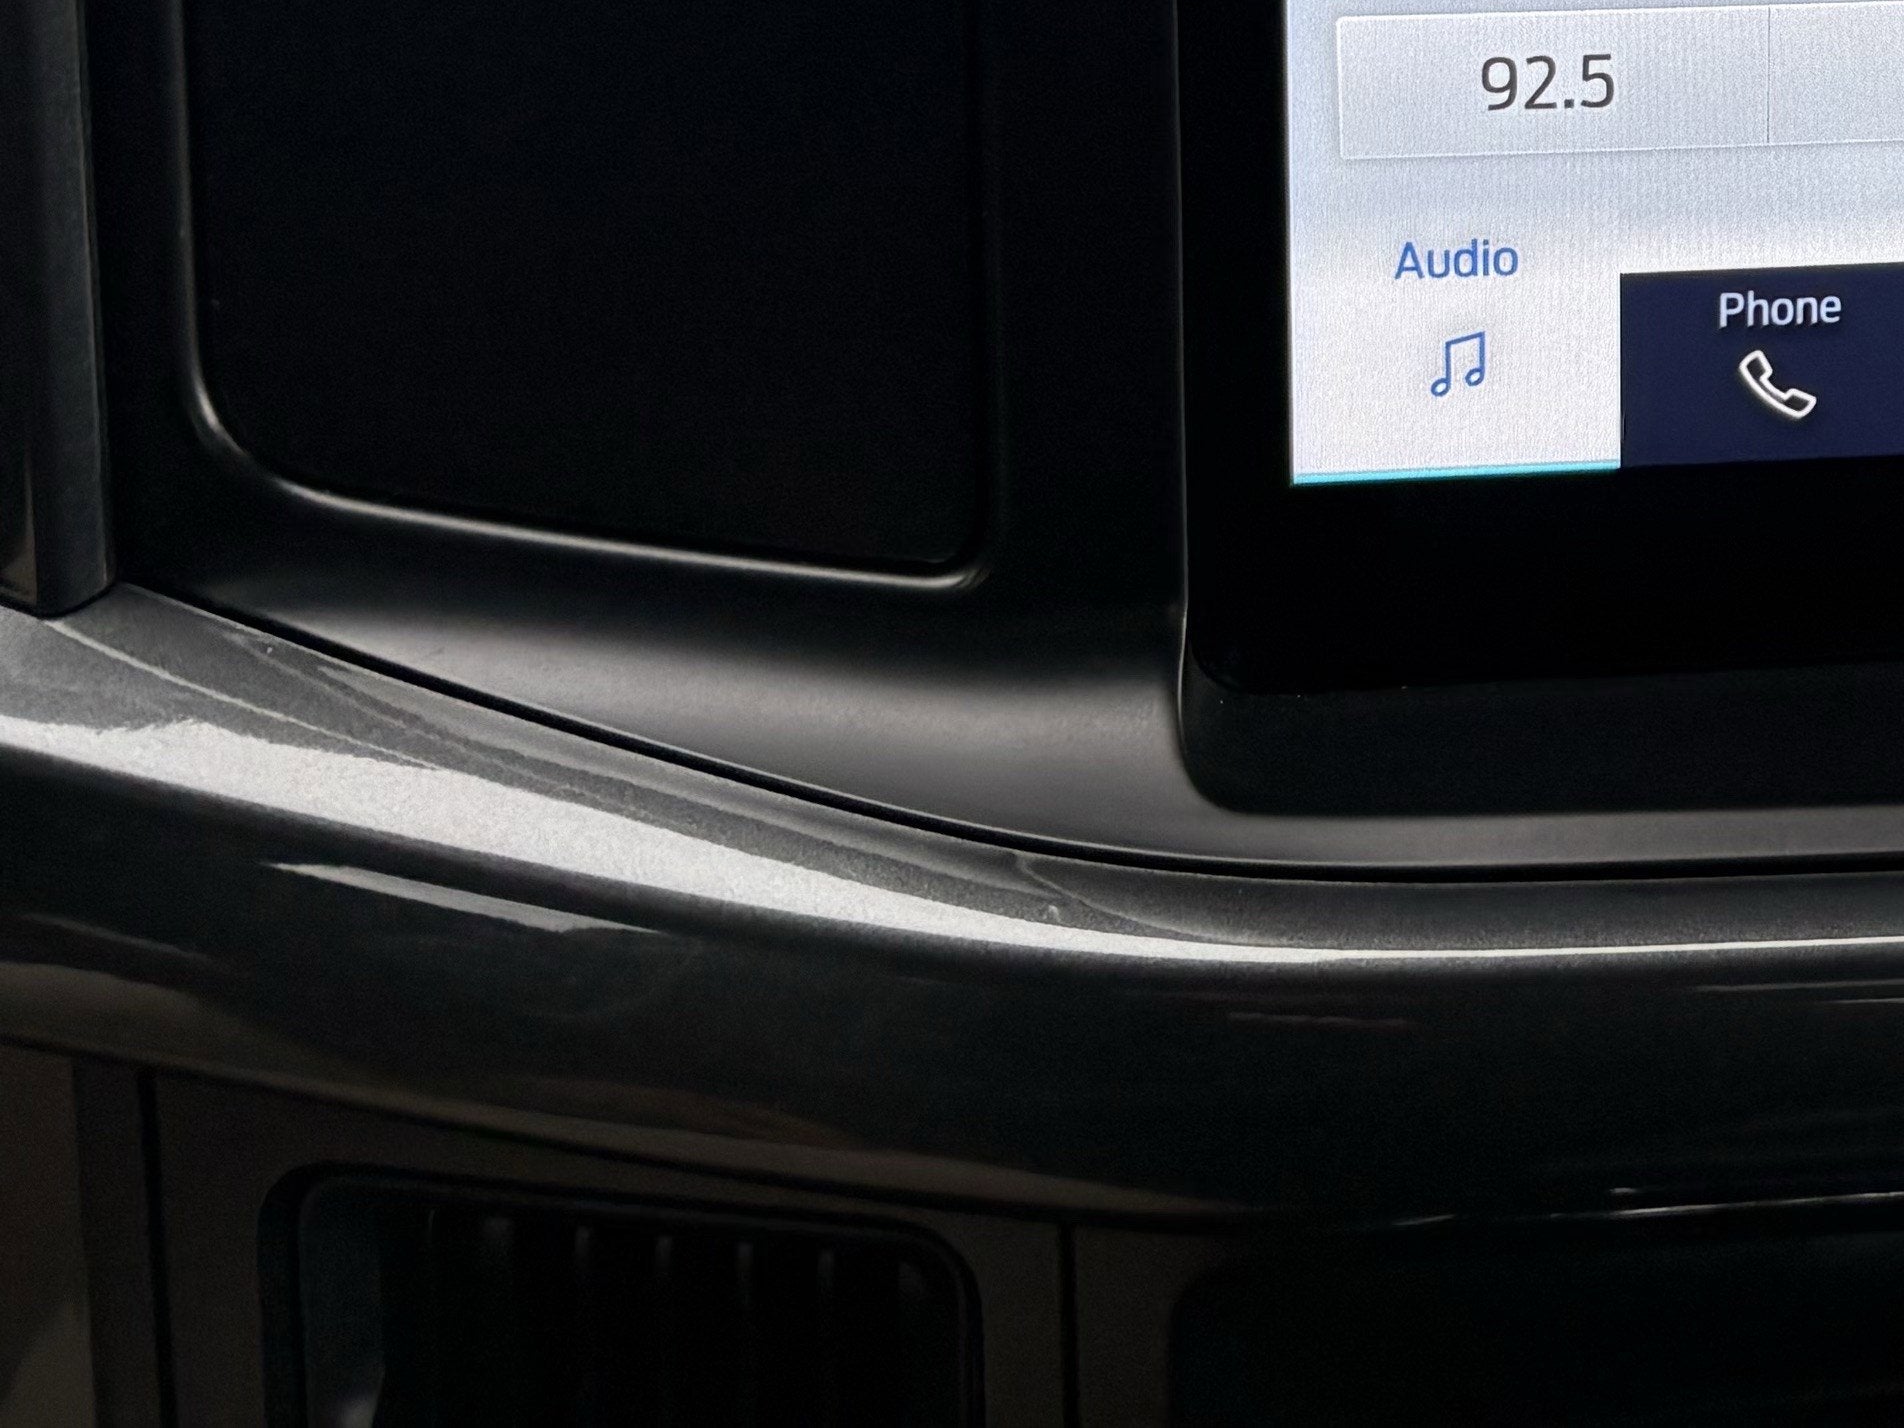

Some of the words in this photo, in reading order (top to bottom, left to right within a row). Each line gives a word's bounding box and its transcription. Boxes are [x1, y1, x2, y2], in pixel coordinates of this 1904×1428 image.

[1480, 53, 1616, 112] 92.5
[1394, 237, 1520, 280] Audio
[1718, 290, 1843, 329] Phone
